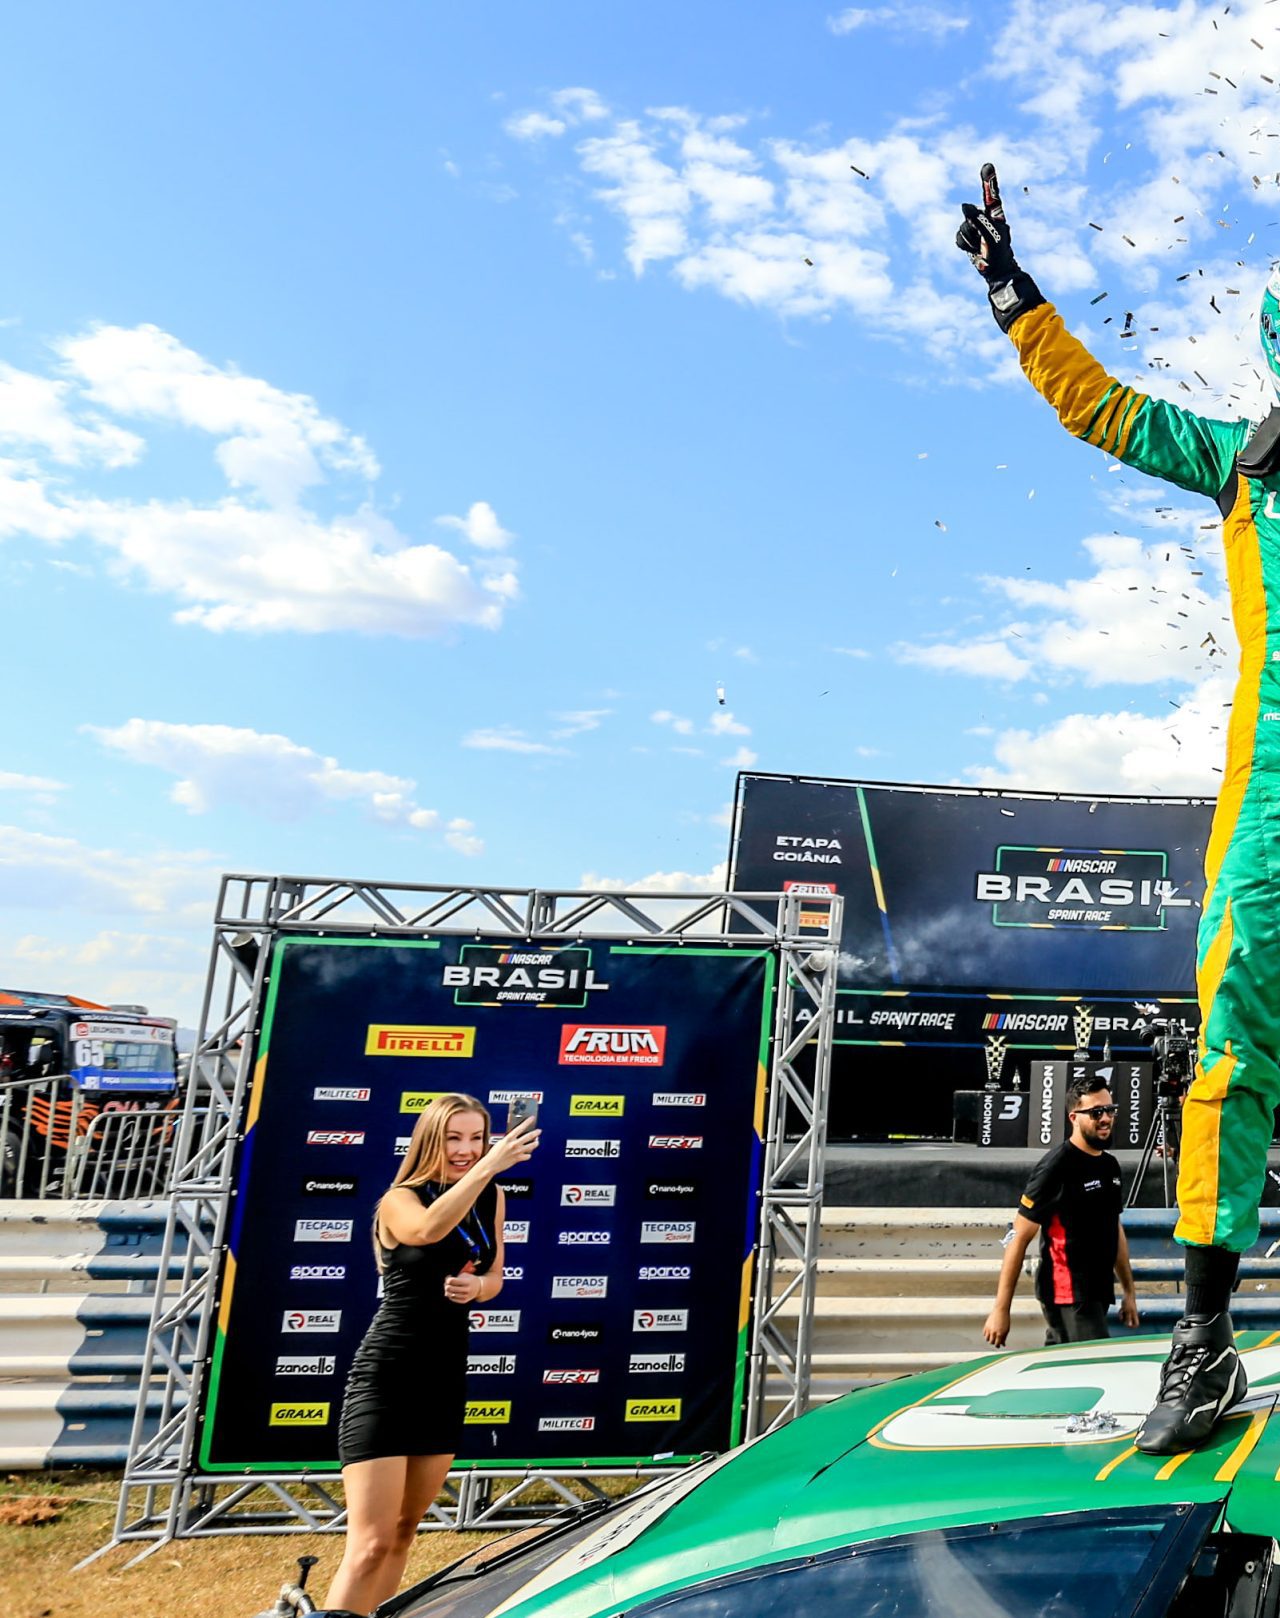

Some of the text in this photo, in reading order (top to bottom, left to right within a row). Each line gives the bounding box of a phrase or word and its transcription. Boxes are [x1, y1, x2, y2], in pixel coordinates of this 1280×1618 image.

[776, 835, 842, 850] ETAPA
[773, 851, 842, 864] GOIÂNIA
[1063, 859, 1118, 874] NASCAR
[976, 874, 1192, 907] BRASIL
[1048, 909, 1112, 921] SPRINT RACE
[511, 954, 553, 965] NASCAR
[442, 966, 610, 990] BRASIL
[496, 992, 547, 1001] SPRINT RACE
[869, 1011, 919, 1027] SPRINT
[918, 1013, 956, 1028] RACE
[1002, 1014, 1069, 1031] NASCAR
[377, 1031, 465, 1051] PIRELLI
[565, 1028, 660, 1053] FRUM
[75, 1040, 104, 1067] 65
[564, 1055, 615, 1063] TECNOLOGIA
[630, 1056, 659, 1064] FREIOS
[405, 1098, 433, 1107] GRA
[574, 1101, 619, 1110] GRAXA
[998, 1095, 1022, 1120] 3
[1040, 1065, 1054, 1144] CHANDON
[1129, 1066, 1141, 1144] CHANDON
[982, 1095, 993, 1145] CHANDON
[310, 1132, 363, 1144] ERT
[652, 1137, 699, 1148] ERT
[566, 1141, 618, 1156] zanoello
[299, 1221, 349, 1230] TECPADS
[644, 1223, 692, 1232] TECPADS
[558, 1231, 610, 1245] sparco
[290, 1266, 346, 1280] sparco
[638, 1266, 691, 1280] sparco
[556, 1278, 604, 1287] TECPADS
[308, 1315, 335, 1323] REAL
[275, 1358, 333, 1373] zanoello
[466, 1357, 514, 1373] anoello
[629, 1355, 682, 1372] zanoello
[546, 1370, 596, 1383] ERT
[275, 1409, 324, 1419] GRAXA
[630, 1405, 676, 1415] GRAXA
